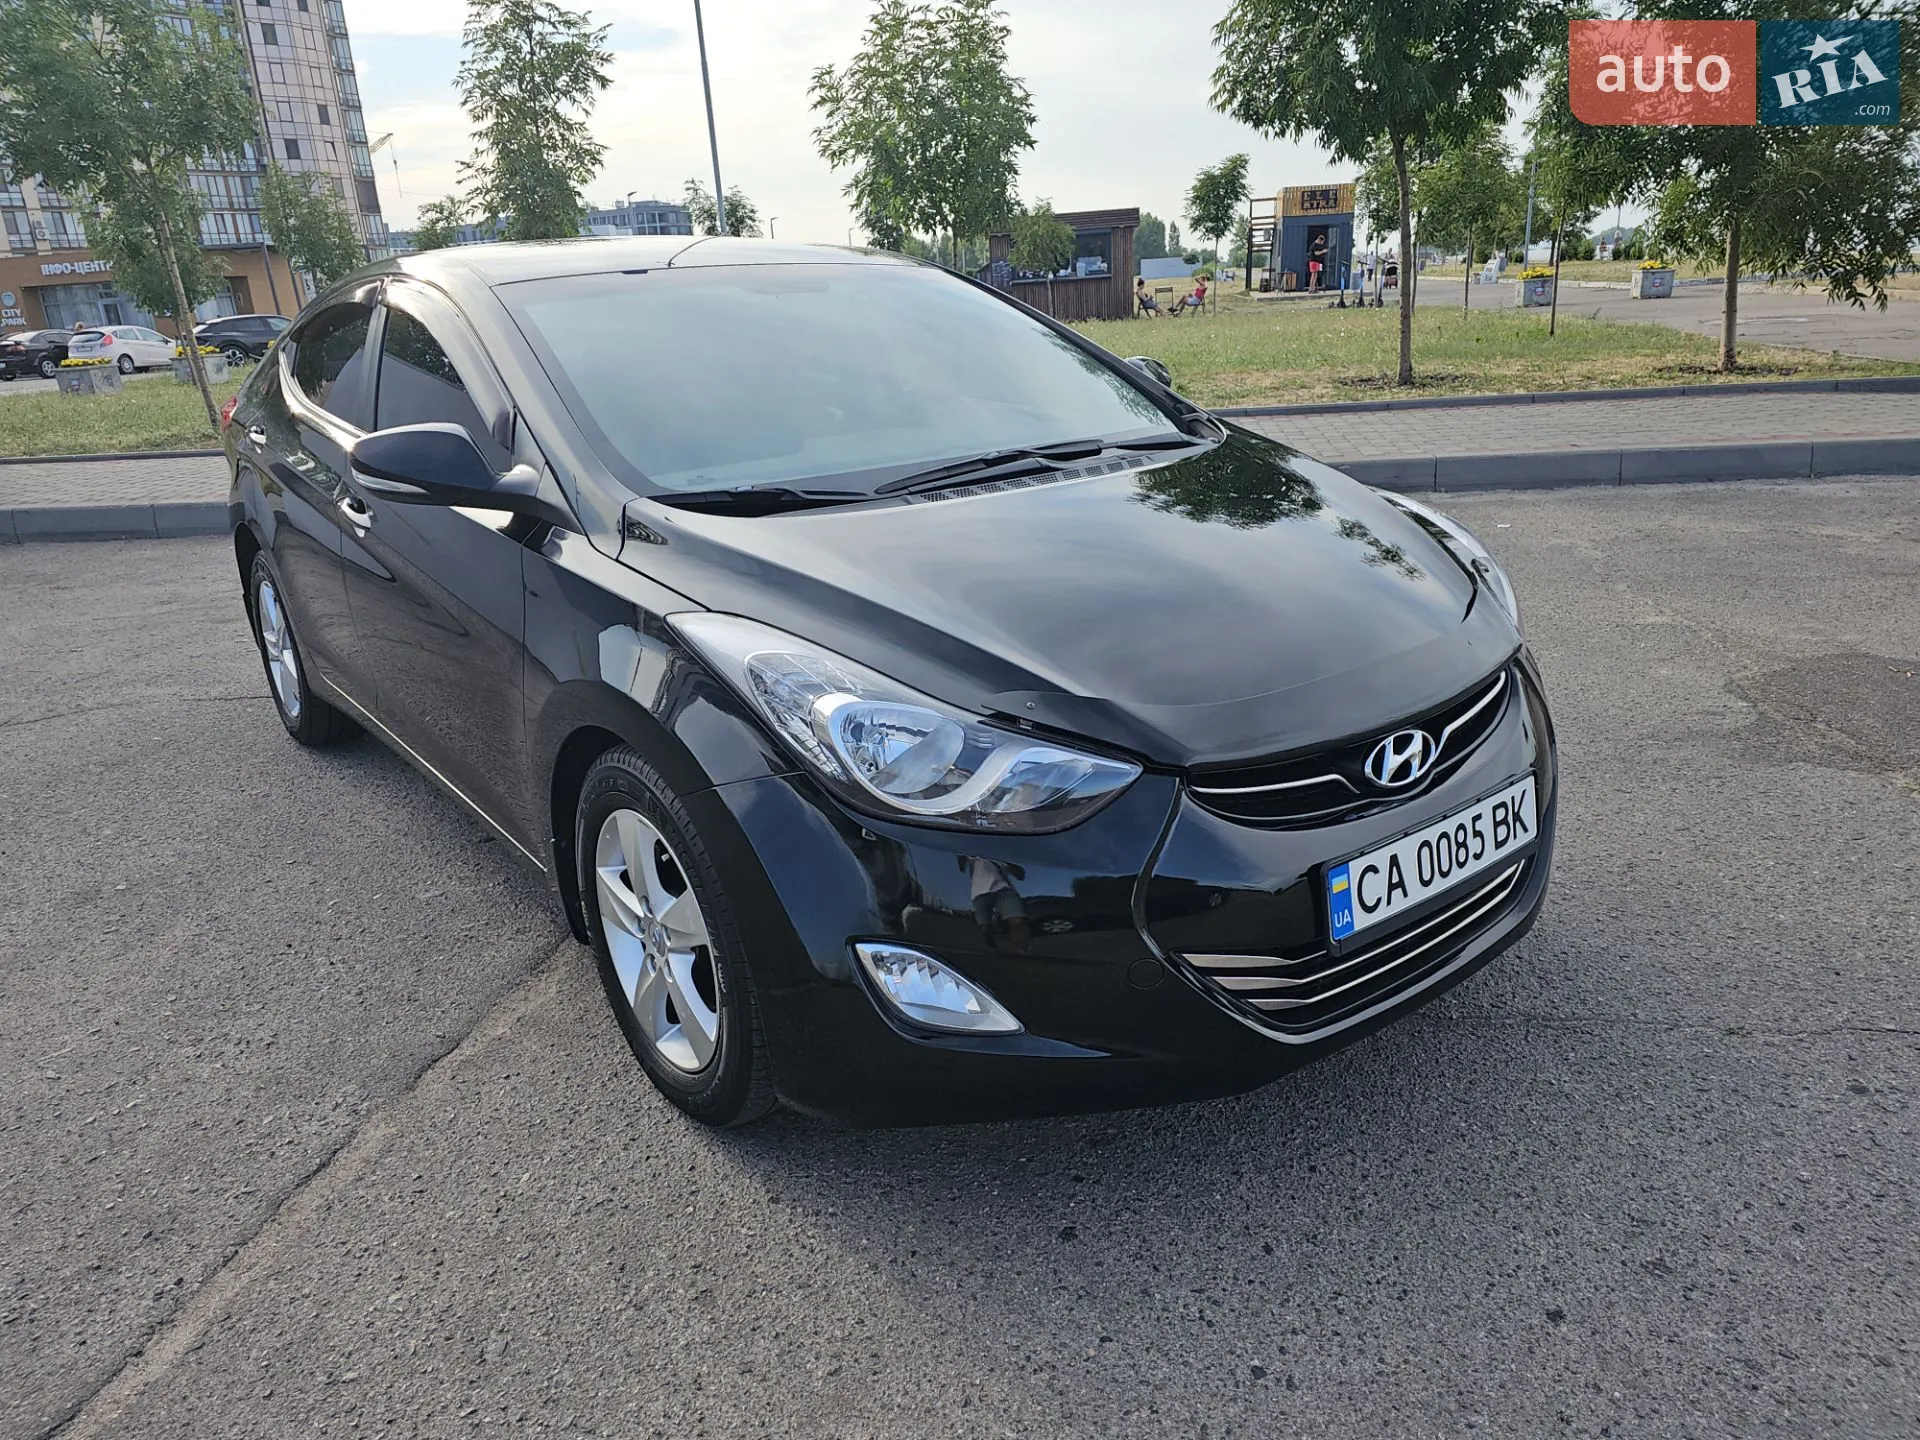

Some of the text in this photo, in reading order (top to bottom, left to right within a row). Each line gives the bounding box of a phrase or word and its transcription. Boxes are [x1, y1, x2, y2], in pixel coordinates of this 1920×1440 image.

[1, 308, 21, 317] CITY
[1356, 788, 1529, 914] CA 0085 BK
[1334, 911, 1352, 928] UA
